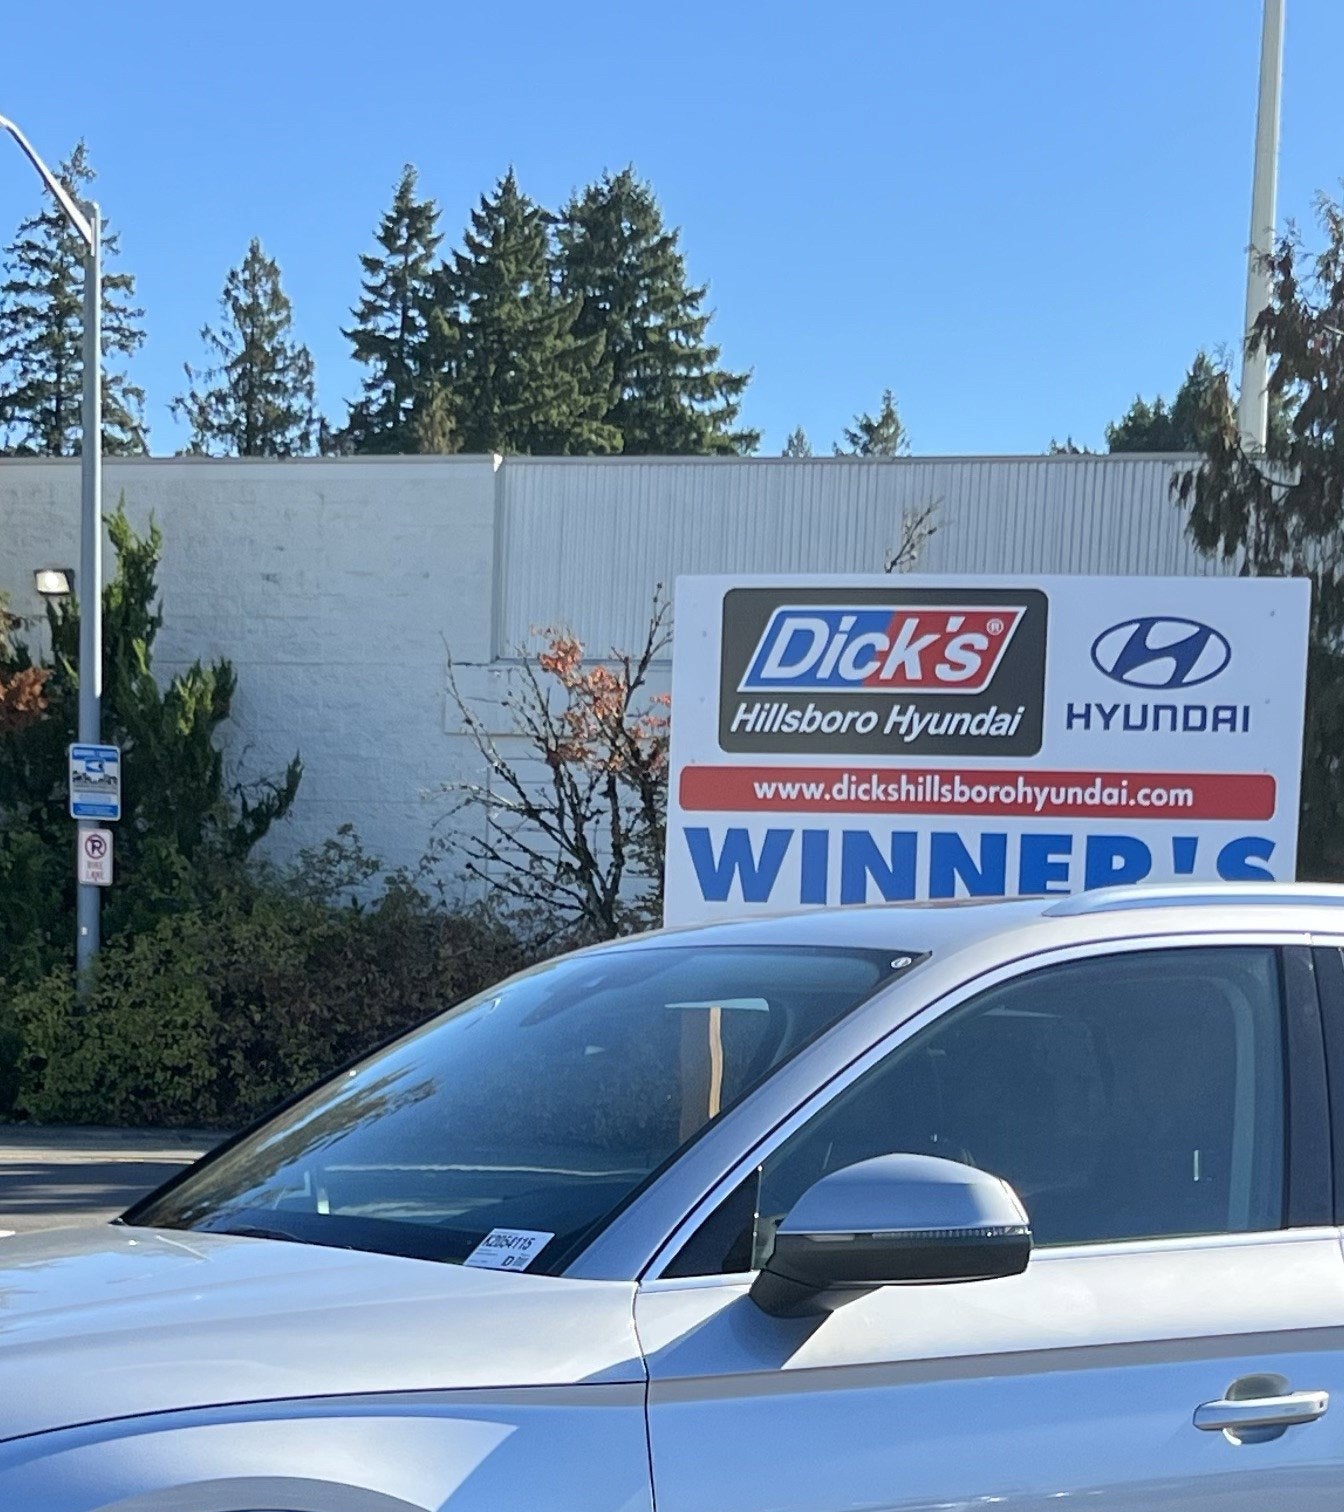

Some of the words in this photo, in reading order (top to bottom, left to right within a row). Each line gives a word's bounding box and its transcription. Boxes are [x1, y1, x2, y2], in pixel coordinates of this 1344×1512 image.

[759, 614, 991, 682] Dick's
[729, 704, 878, 736] Hillsboro
[883, 705, 1025, 743] Hyundai
[1066, 703, 1250, 734] HYUNDAI
[753, 773, 1195, 813] www.dickshillsborohyundai.com
